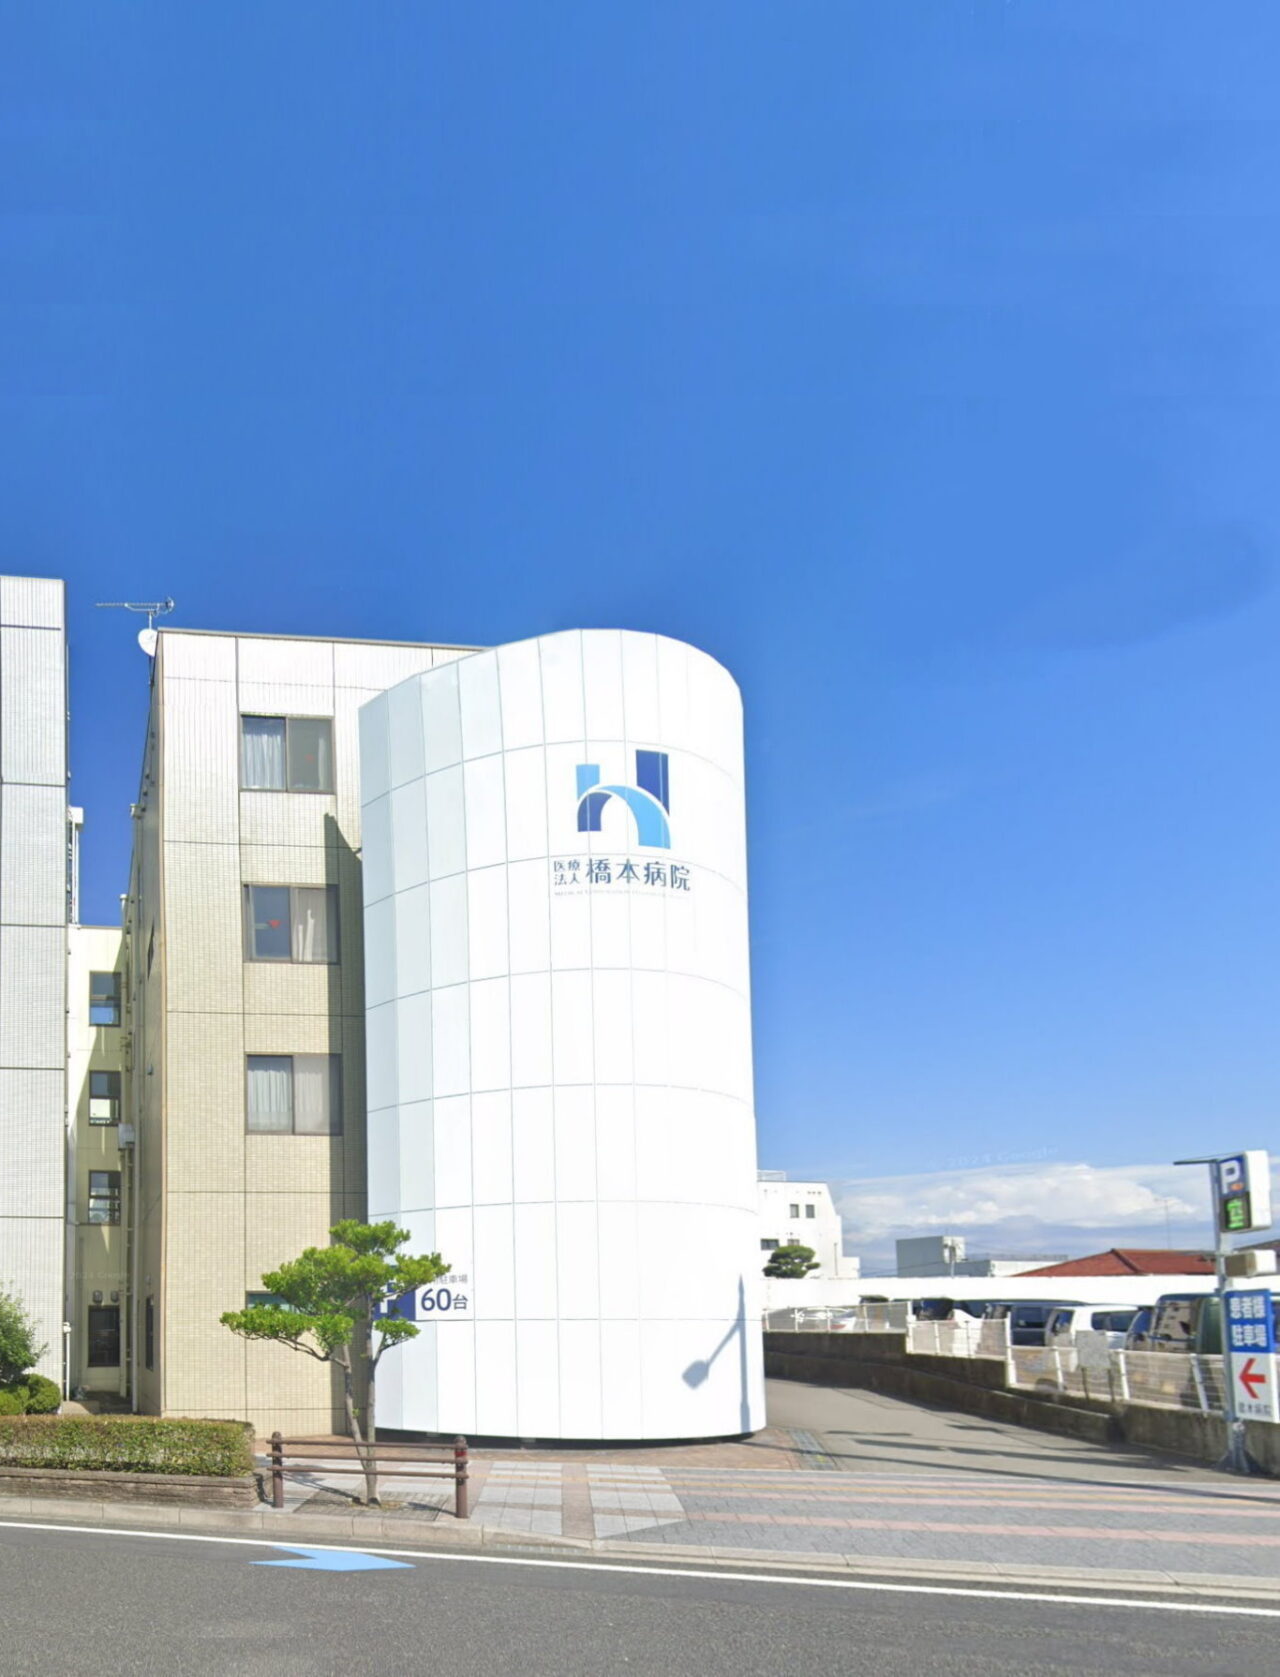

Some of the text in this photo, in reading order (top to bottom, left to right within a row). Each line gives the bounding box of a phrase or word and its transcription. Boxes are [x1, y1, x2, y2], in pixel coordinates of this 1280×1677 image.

[553, 859, 580, 872] 医療
[585, 858, 690, 891] 橋本病院
[554, 872, 580, 886] 法人
[1220, 1160, 1240, 1195] P
[421, 1288, 468, 1311] 60台
[1231, 1324, 1268, 1347] 駐車場
